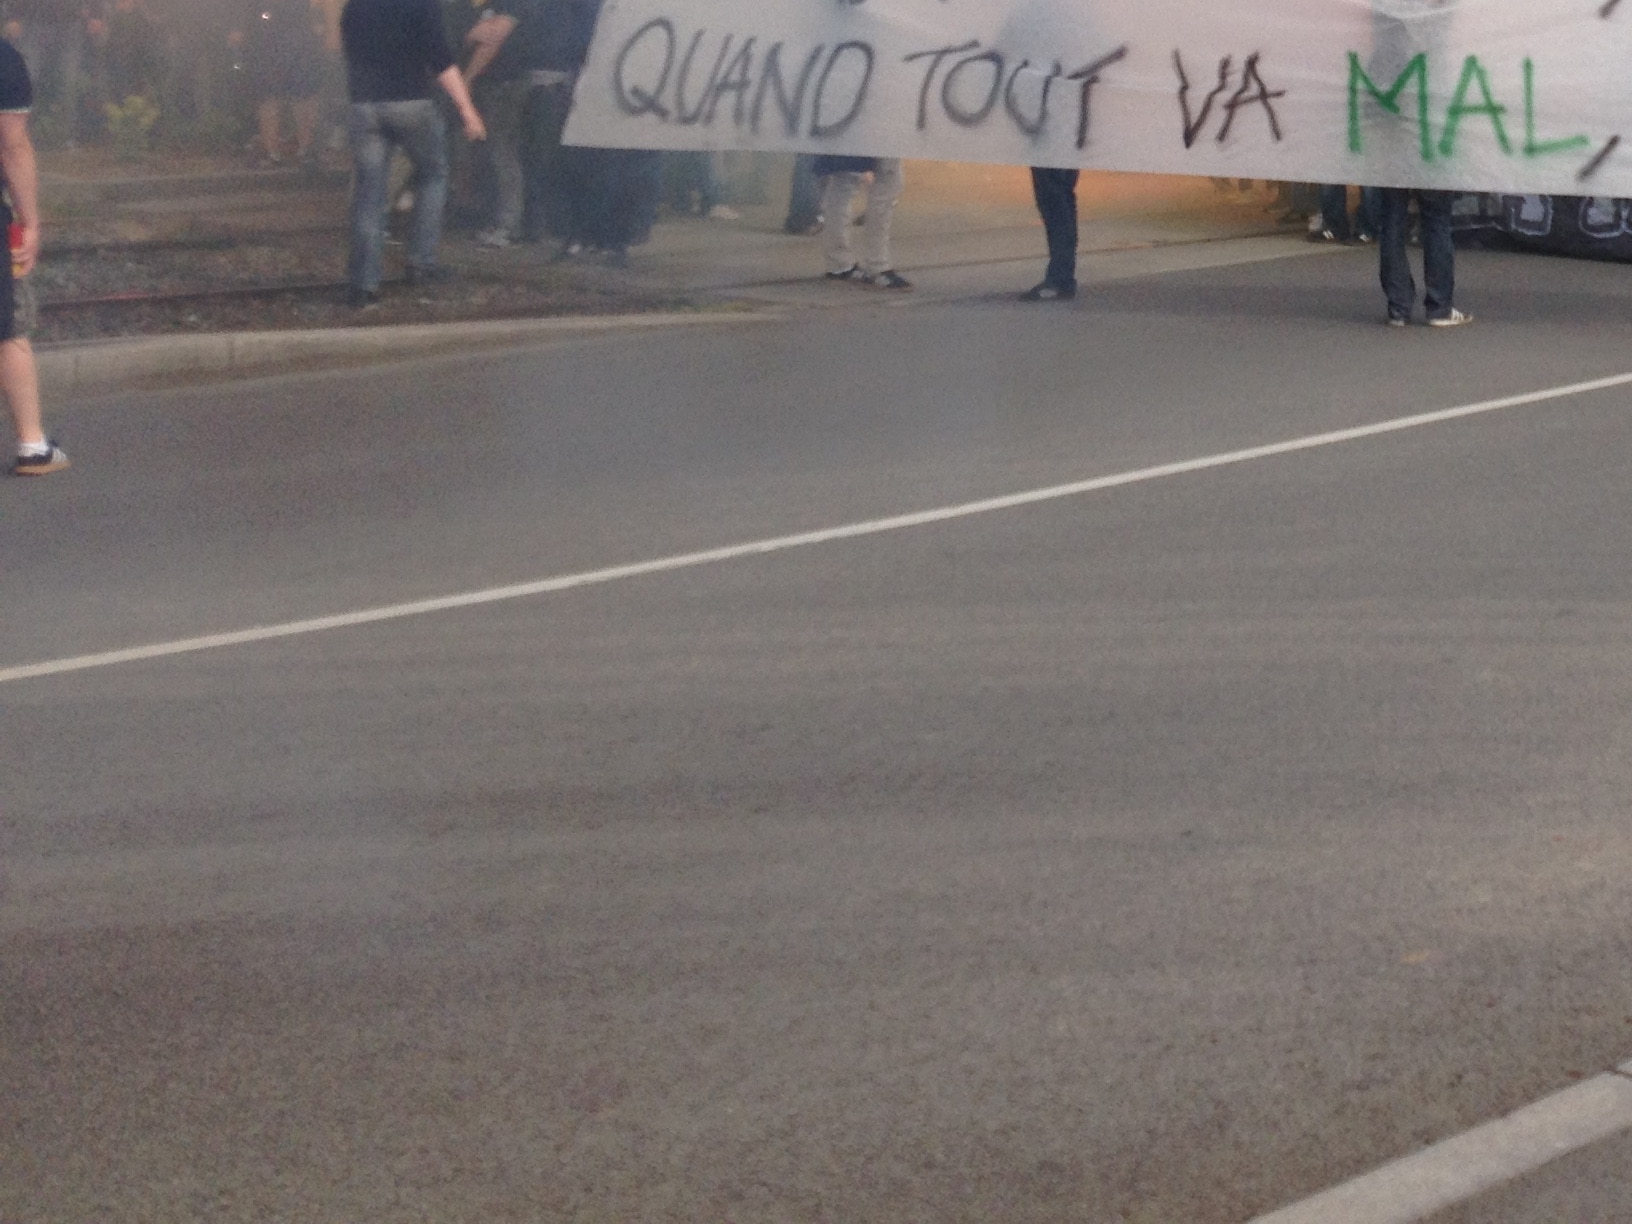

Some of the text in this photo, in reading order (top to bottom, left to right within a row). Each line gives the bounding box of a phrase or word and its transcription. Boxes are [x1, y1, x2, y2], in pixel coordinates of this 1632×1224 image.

[611, 17, 876, 138] QUAND
[904, 39, 1129, 149] TOUT
[1173, 48, 1287, 149] VA
